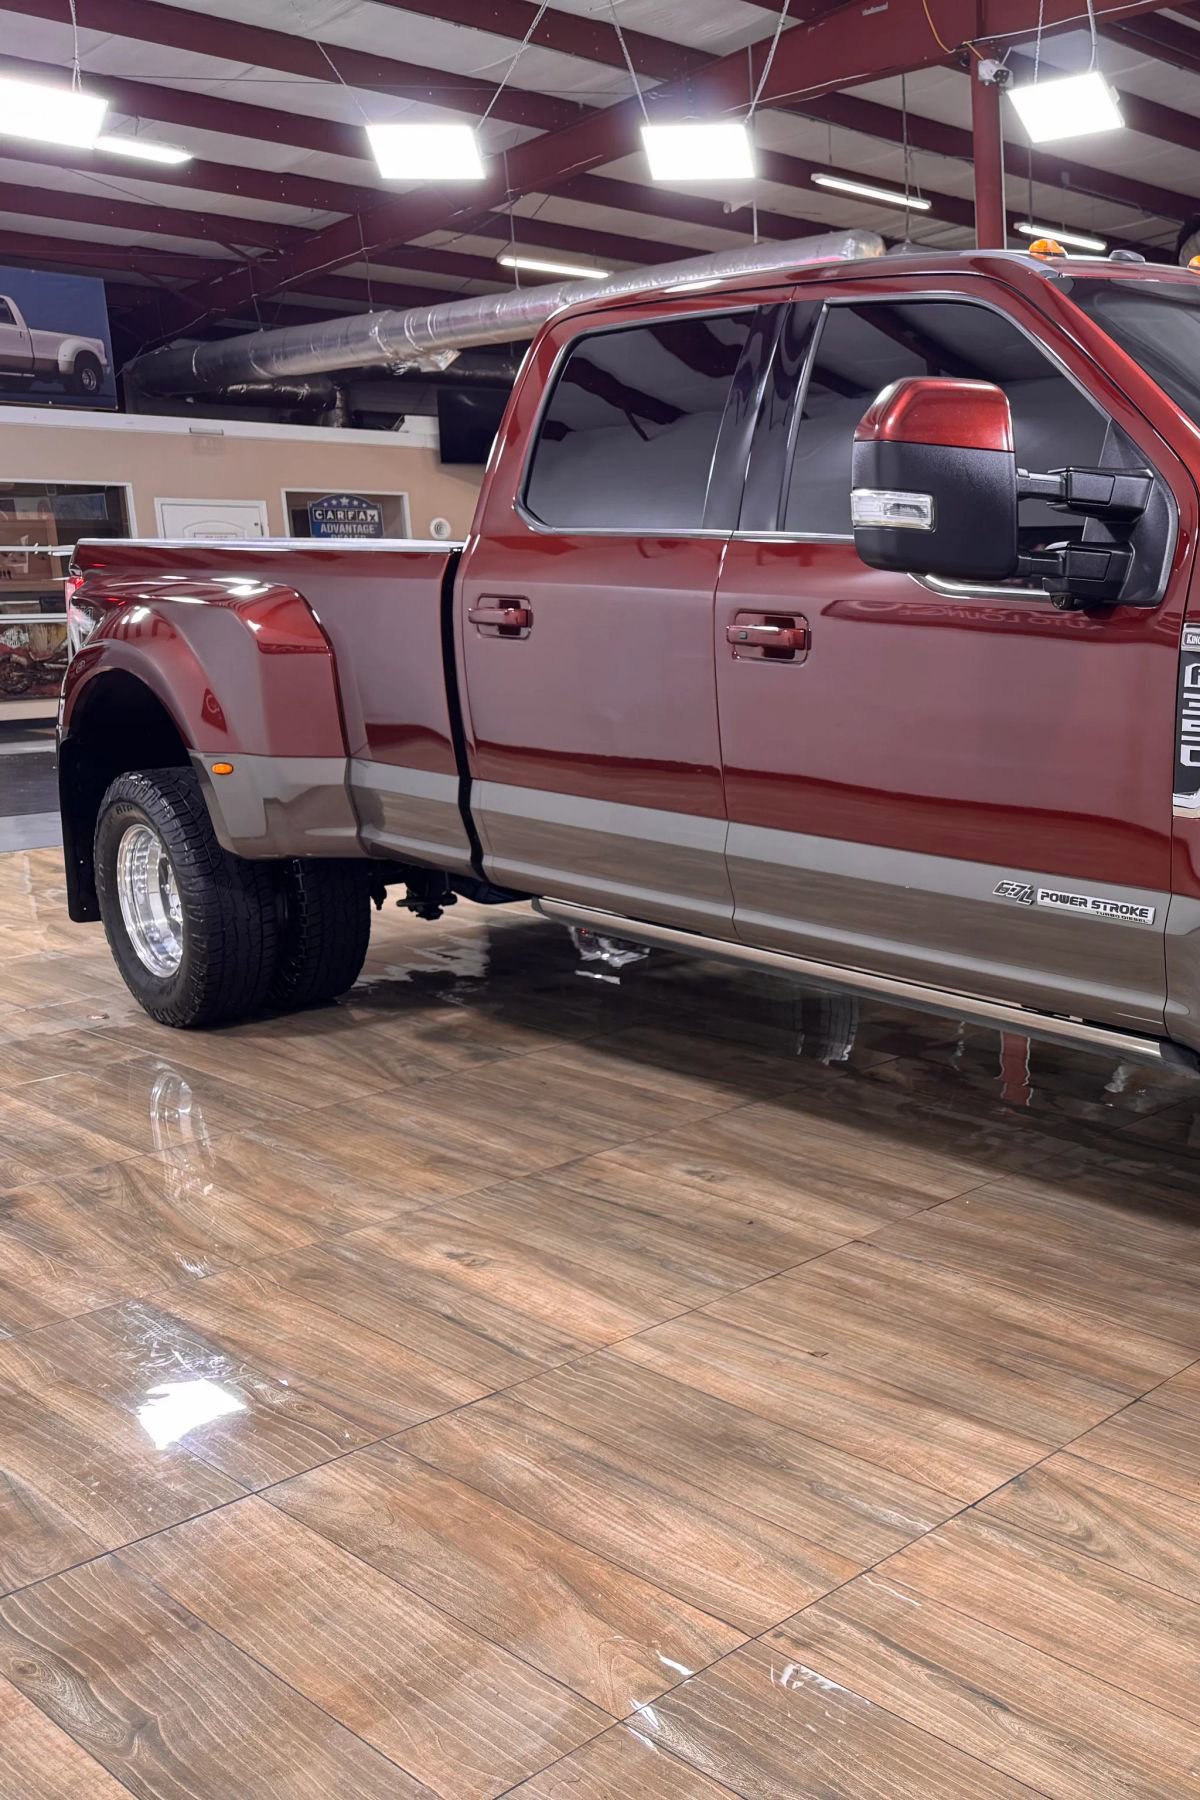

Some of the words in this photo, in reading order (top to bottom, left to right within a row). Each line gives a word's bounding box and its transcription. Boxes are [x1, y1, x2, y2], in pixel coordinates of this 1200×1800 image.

[315, 510, 377, 520] CARFAX
[320, 523, 375, 534] ADVANTAGE
[1041, 891, 1088, 908] POWER
[1091, 900, 1149, 919] STROKE
